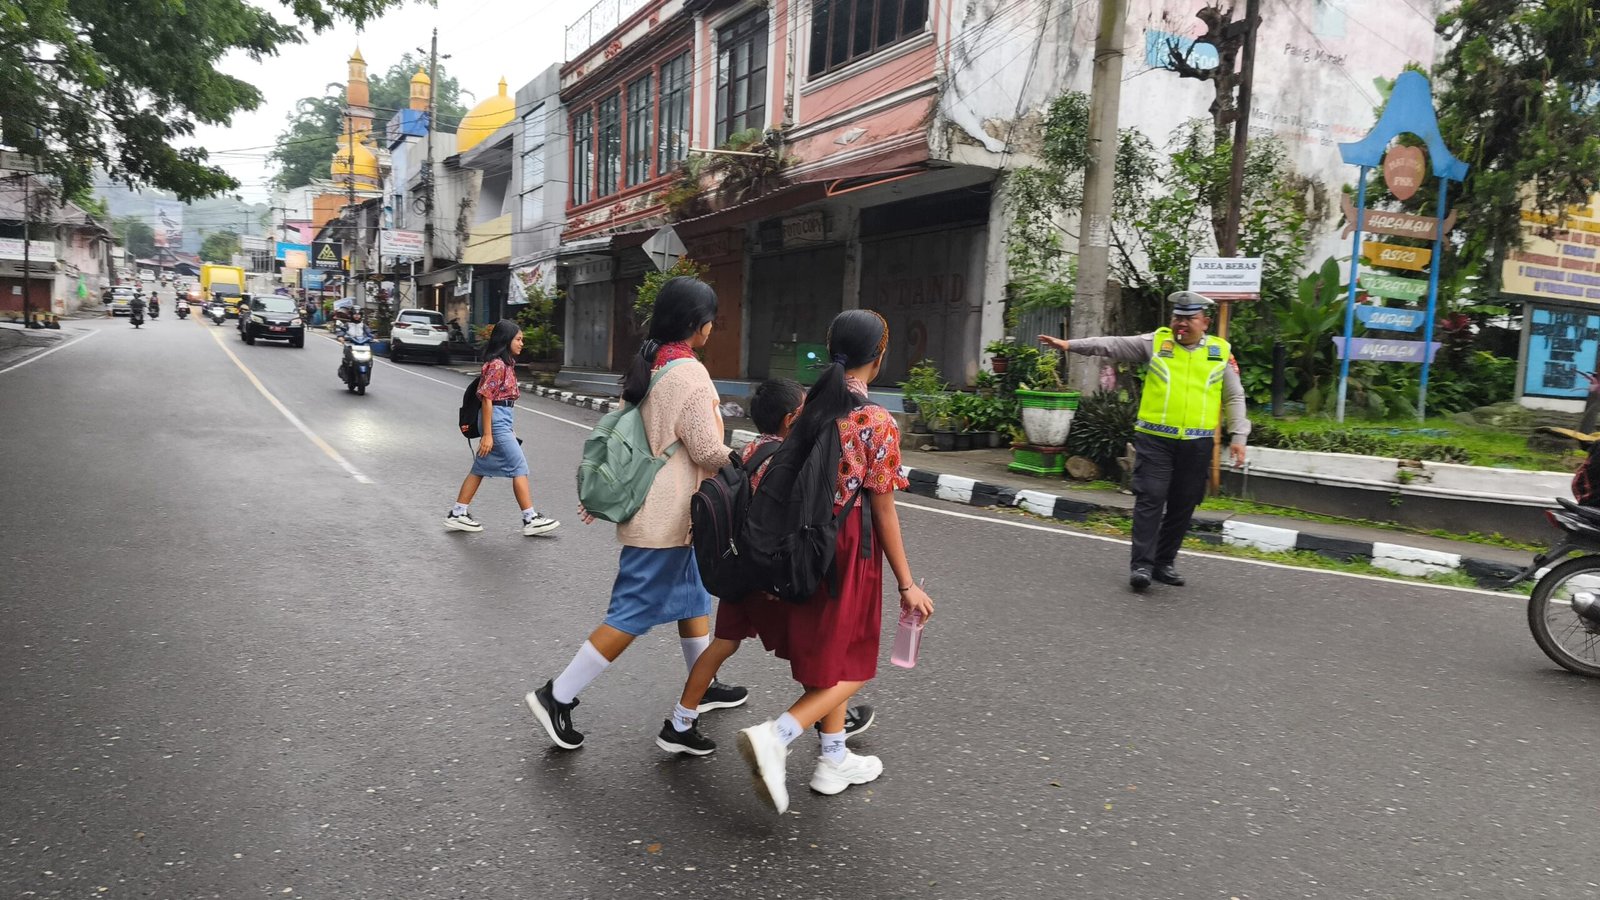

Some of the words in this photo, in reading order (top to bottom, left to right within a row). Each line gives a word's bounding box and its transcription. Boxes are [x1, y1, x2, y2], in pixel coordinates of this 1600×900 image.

[1368, 215, 1434, 232] HALAMAN
[1196, 262, 1224, 270] AREA
[1225, 262, 1258, 270] BEBAS
[1359, 343, 1419, 359] NYAMAN
